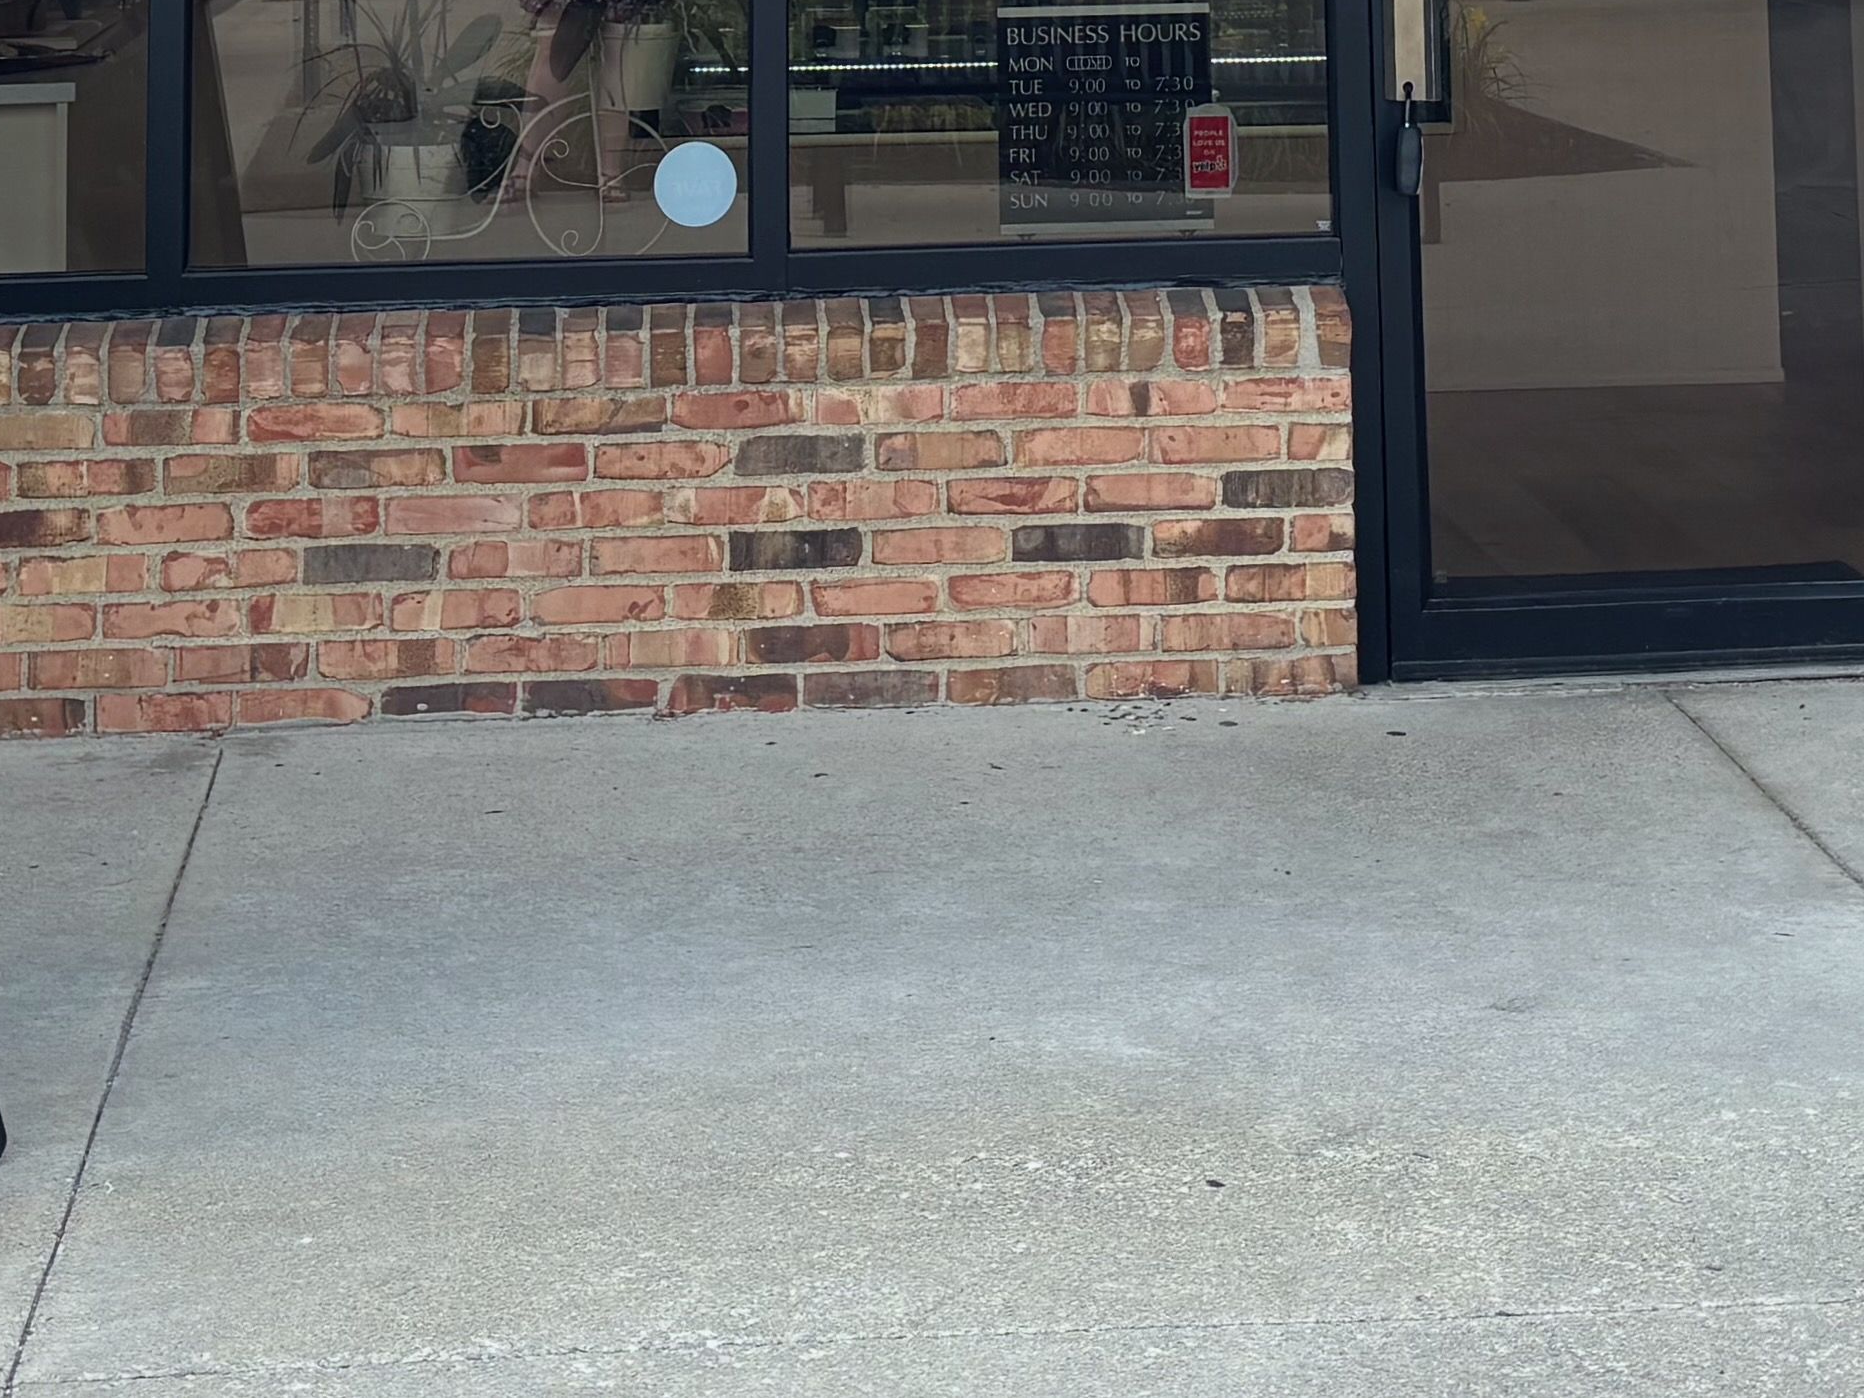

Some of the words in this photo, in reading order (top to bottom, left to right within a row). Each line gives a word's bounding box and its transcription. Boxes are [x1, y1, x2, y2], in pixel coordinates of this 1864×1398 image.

[1007, 24, 1109, 45] BUSINESS
[1120, 22, 1201, 43] HOURS
[1008, 56, 1053, 72] MON
[1009, 79, 1043, 95] TUE
[1125, 79, 1141, 90] TO
[1155, 76, 1194, 92] 7:30
[1010, 102, 1052, 118] WED
[1126, 102, 1141, 113] TO
[1010, 124, 1048, 140] THU
[1126, 124, 1141, 136] TO
[1155, 122, 1181, 137] 7:3
[1010, 148, 1036, 163] FRI
[1126, 148, 1142, 159] TO
[1155, 145, 1183, 160] 7:3
[1010, 170, 1042, 185] SAT
[1010, 193, 1048, 209] SUN
